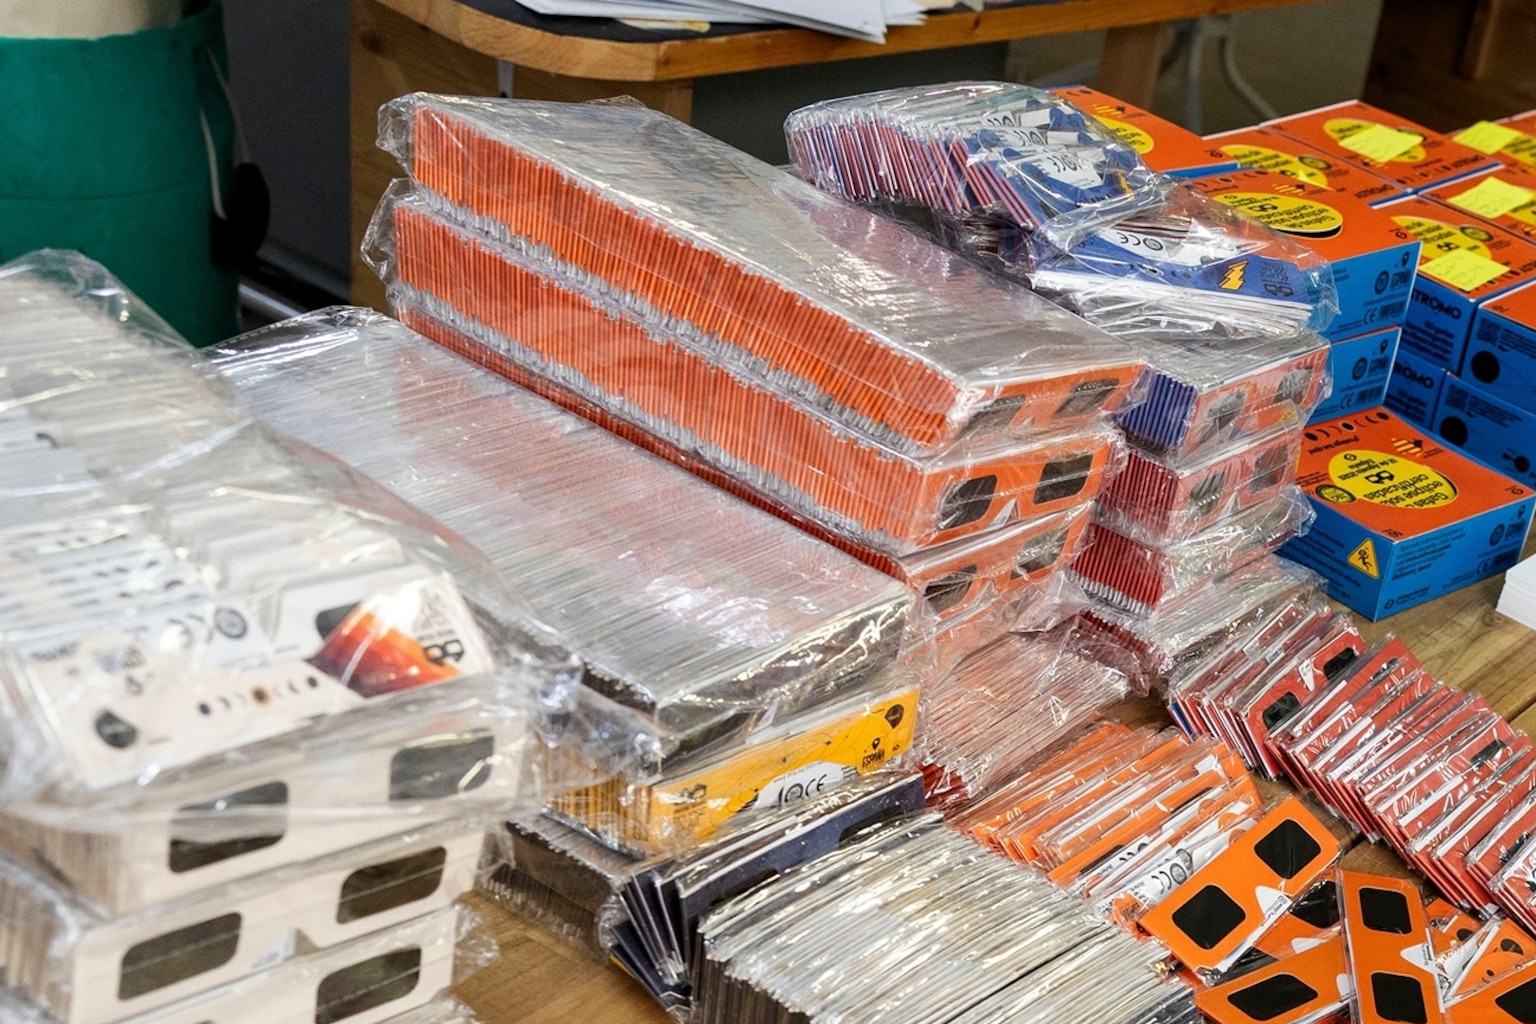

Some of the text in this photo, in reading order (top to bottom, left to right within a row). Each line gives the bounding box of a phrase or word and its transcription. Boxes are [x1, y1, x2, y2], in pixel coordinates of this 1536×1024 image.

[1410, 288, 1462, 320] TROMO
[1363, 473, 1430, 501] certificadas
[1402, 480, 1444, 499] eclipse
[1412, 492, 1450, 508] Gafas
